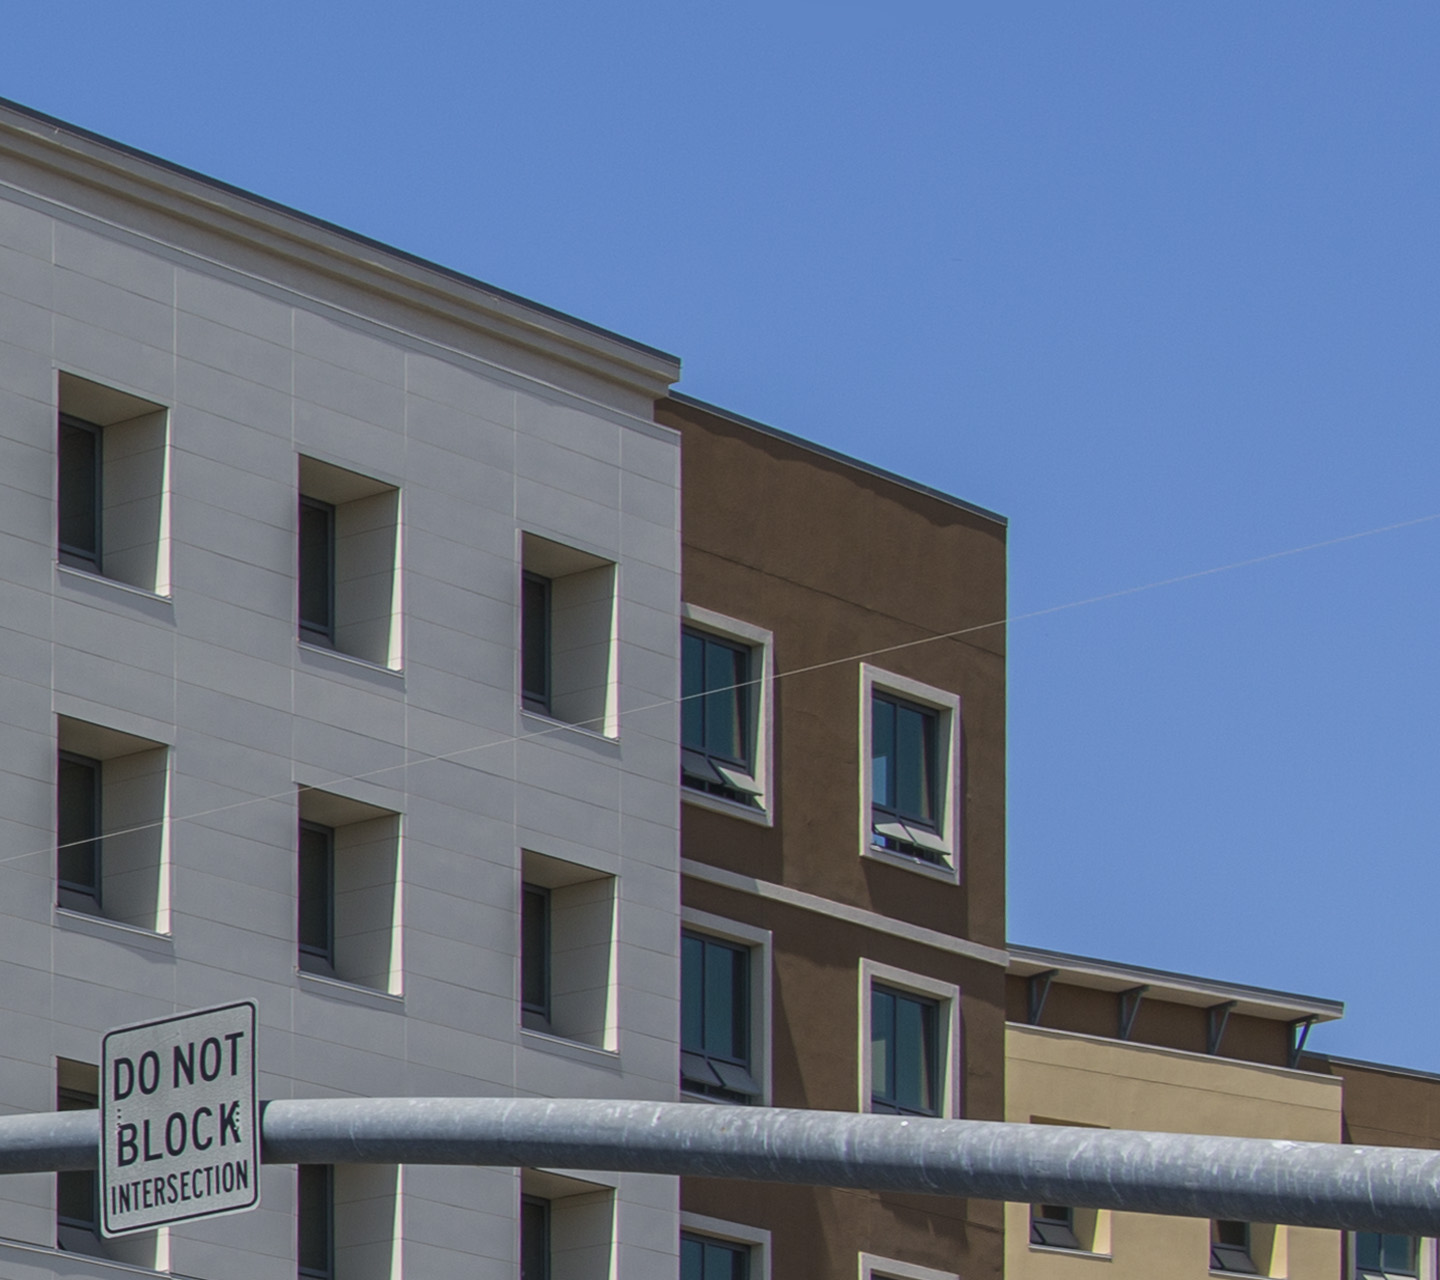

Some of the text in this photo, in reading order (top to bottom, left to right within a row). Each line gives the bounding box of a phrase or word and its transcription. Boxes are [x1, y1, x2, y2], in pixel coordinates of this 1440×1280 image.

[113, 1031, 245, 1101] DO NOT
[116, 1100, 242, 1168] BLOCK
[111, 1159, 248, 1216] INTERSECTION
